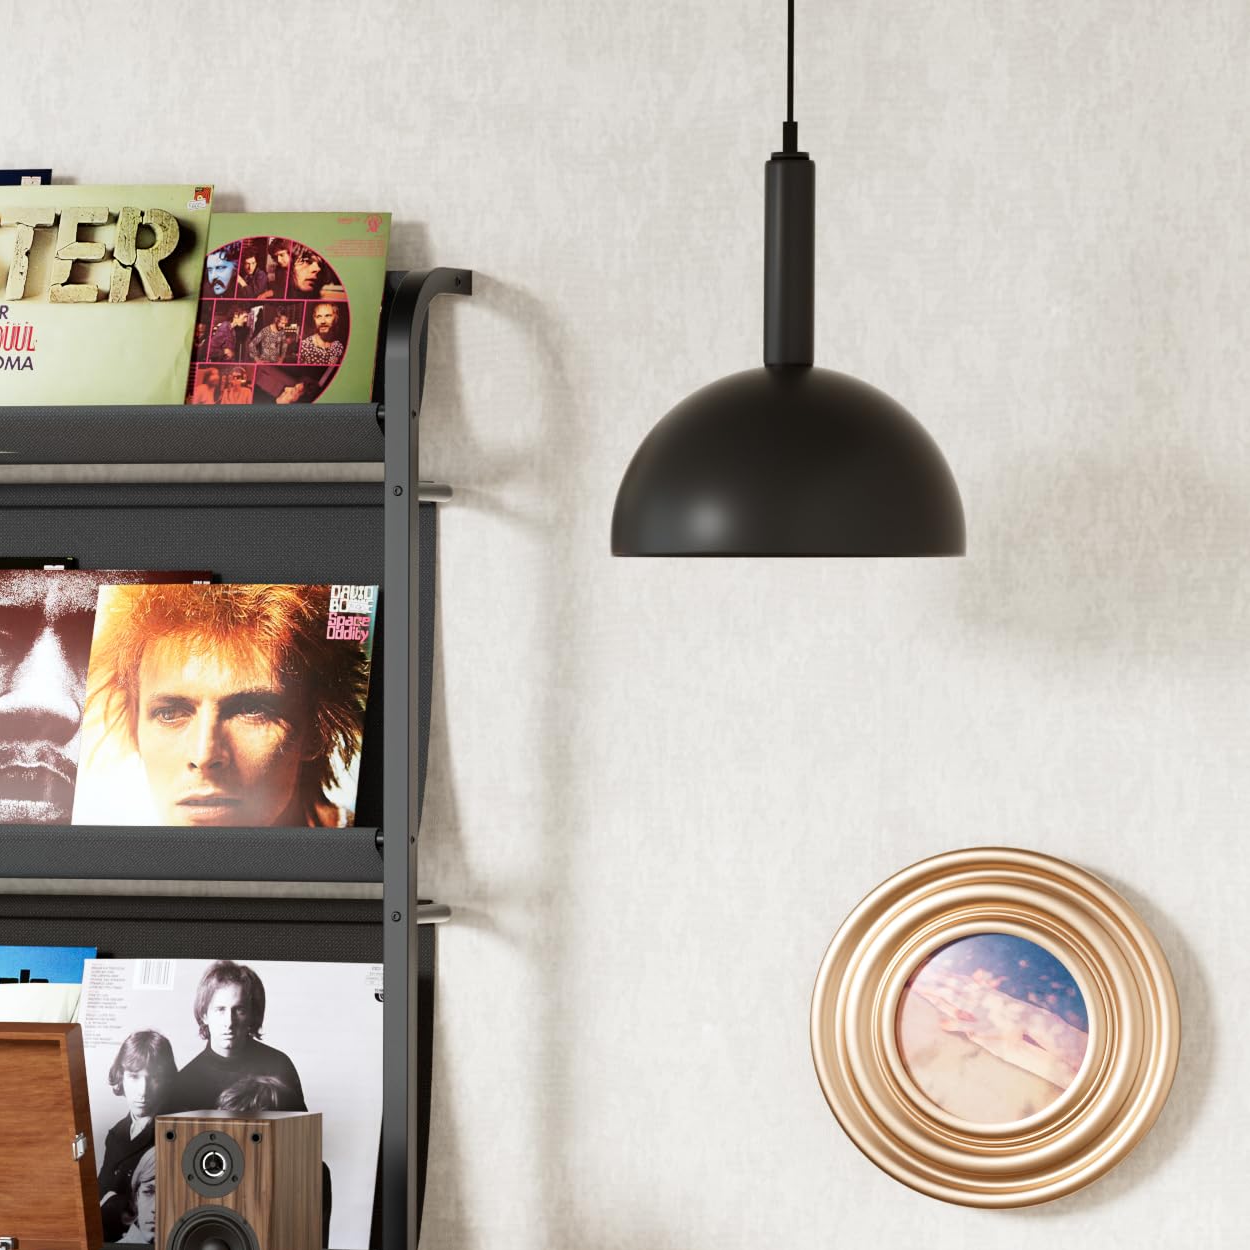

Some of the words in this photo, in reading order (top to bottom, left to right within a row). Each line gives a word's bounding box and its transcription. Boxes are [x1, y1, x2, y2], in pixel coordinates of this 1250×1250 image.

[330, 585, 374, 600] DAVID
[329, 599, 374, 613] BOE
[328, 612, 371, 630] Space
[326, 625, 369, 645] Oddity
